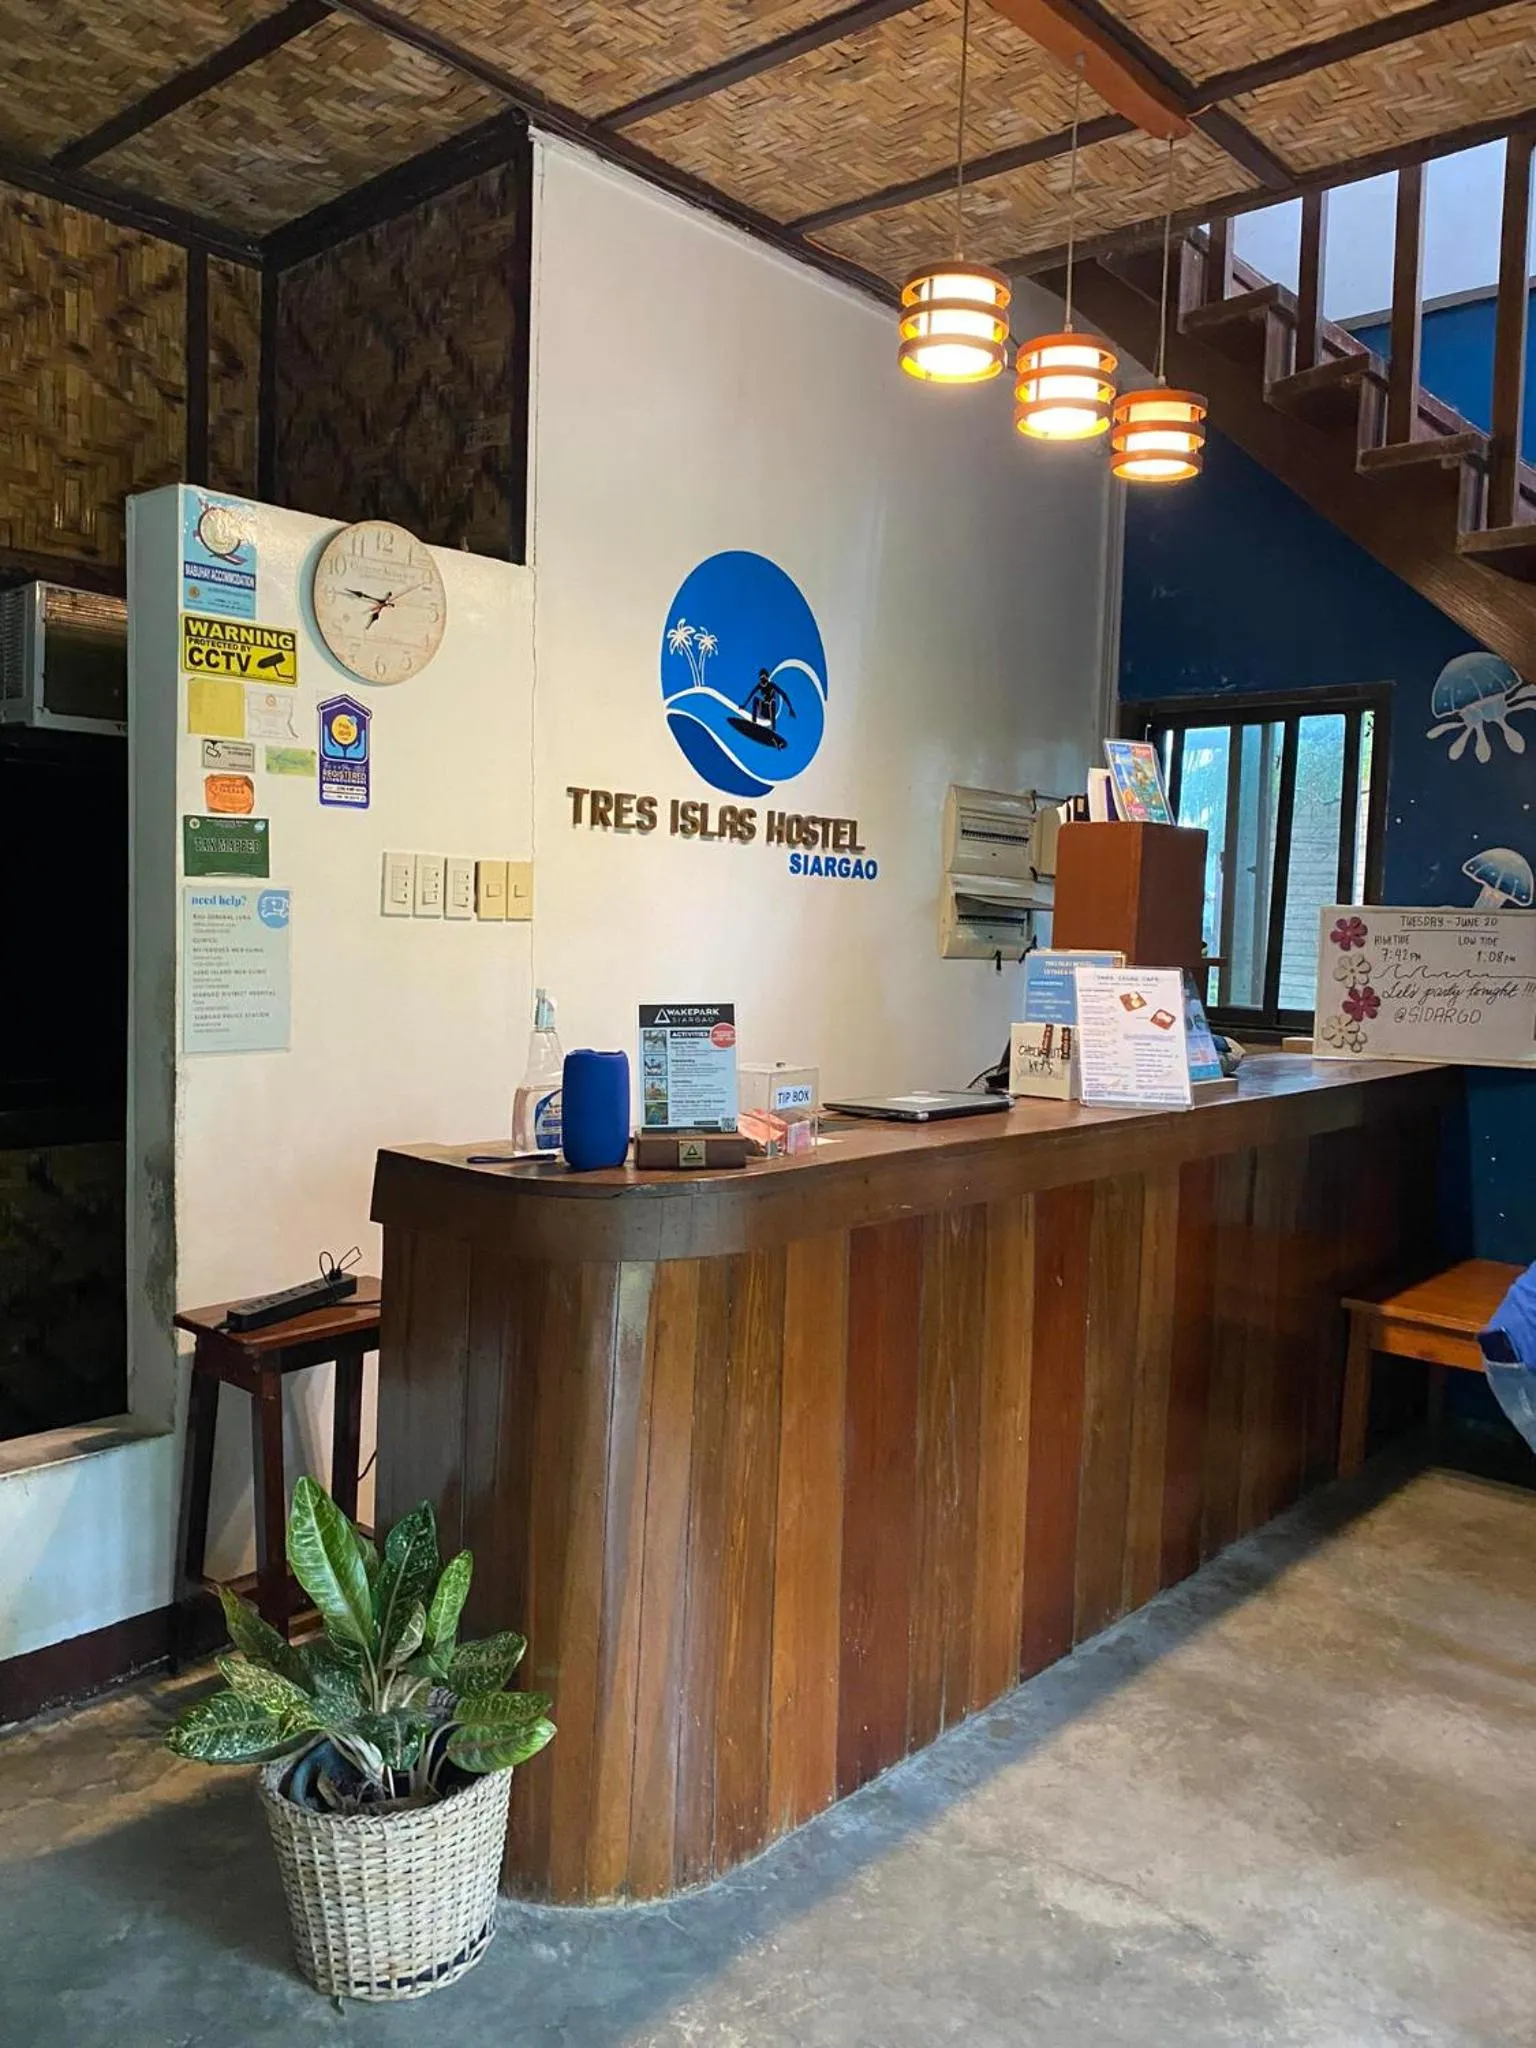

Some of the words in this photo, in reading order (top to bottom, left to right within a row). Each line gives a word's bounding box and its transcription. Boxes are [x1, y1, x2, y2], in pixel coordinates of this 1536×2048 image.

[187, 619, 294, 650] WARNING
[187, 637, 240, 651] PROTECTED
[188, 646, 252, 673] CCTV
[566, 786, 658, 834] TRES
[669, 799, 757, 843] ISLAS
[766, 810, 866, 852] HOSTEL
[788, 853, 878, 880] SIARGAO
[191, 895, 217, 906] need
[218, 895, 247, 907] help?
[1400, 915, 1444, 928] TUESDAY
[1455, 916, 1481, 927] JUNE
[1483, 917, 1498, 927] 20
[1393, 934, 1410, 945] TIDE
[1458, 936, 1477, 947] LOW
[1480, 936, 1499, 948] TIDE
[1382, 981, 1421, 999] Let's
[667, 1008, 720, 1016] WAKEPARK
[777, 1091, 791, 1105] TIP
[791, 1090, 810, 1103] BOX
